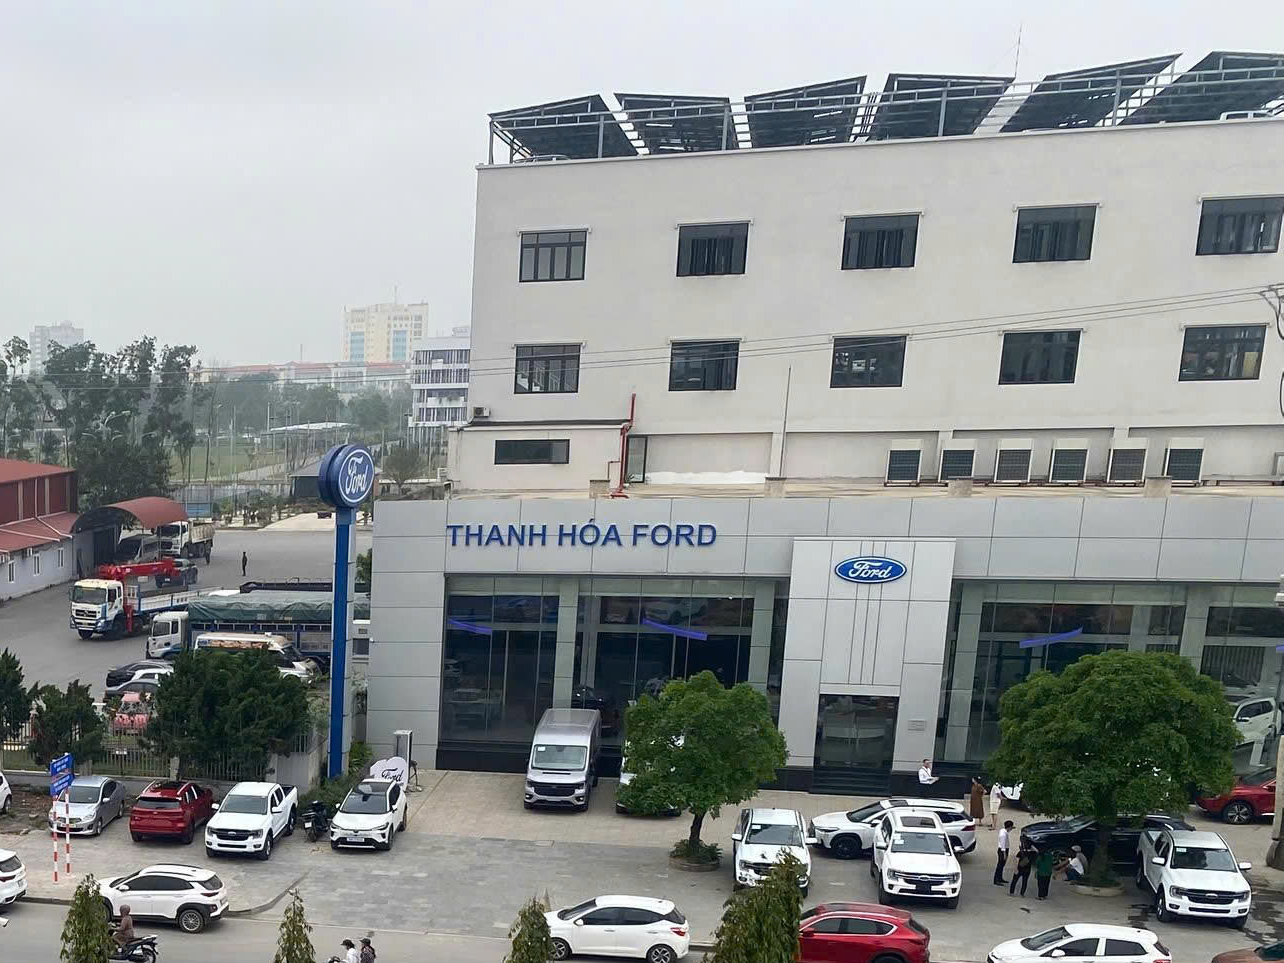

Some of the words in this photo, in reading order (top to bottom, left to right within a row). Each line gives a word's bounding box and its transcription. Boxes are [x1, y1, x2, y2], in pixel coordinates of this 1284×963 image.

[345, 456, 369, 495] Ford
[446, 524, 548, 547] THANH
[558, 518, 623, 547] HÓA
[632, 524, 717, 547] FORD
[848, 561, 893, 579] Ford
[382, 767, 404, 782] Ford
